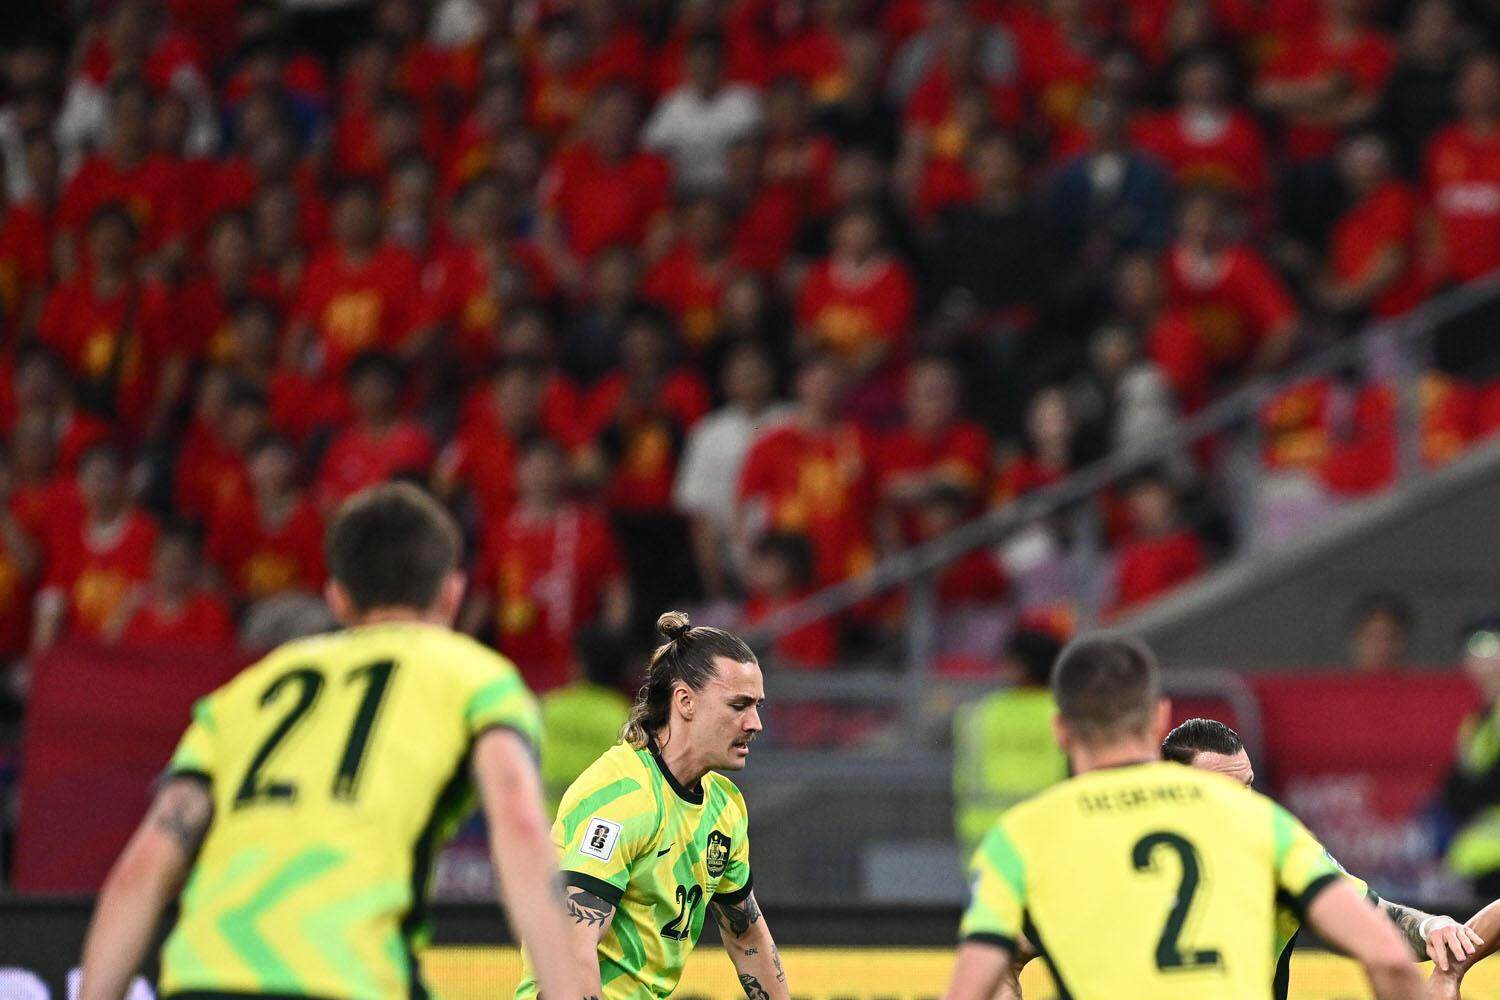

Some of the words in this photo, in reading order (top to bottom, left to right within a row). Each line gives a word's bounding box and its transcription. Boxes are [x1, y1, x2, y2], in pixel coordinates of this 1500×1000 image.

[232, 659, 398, 811] 21
[659, 884, 703, 941] 22
[1131, 830, 1222, 971] 2
